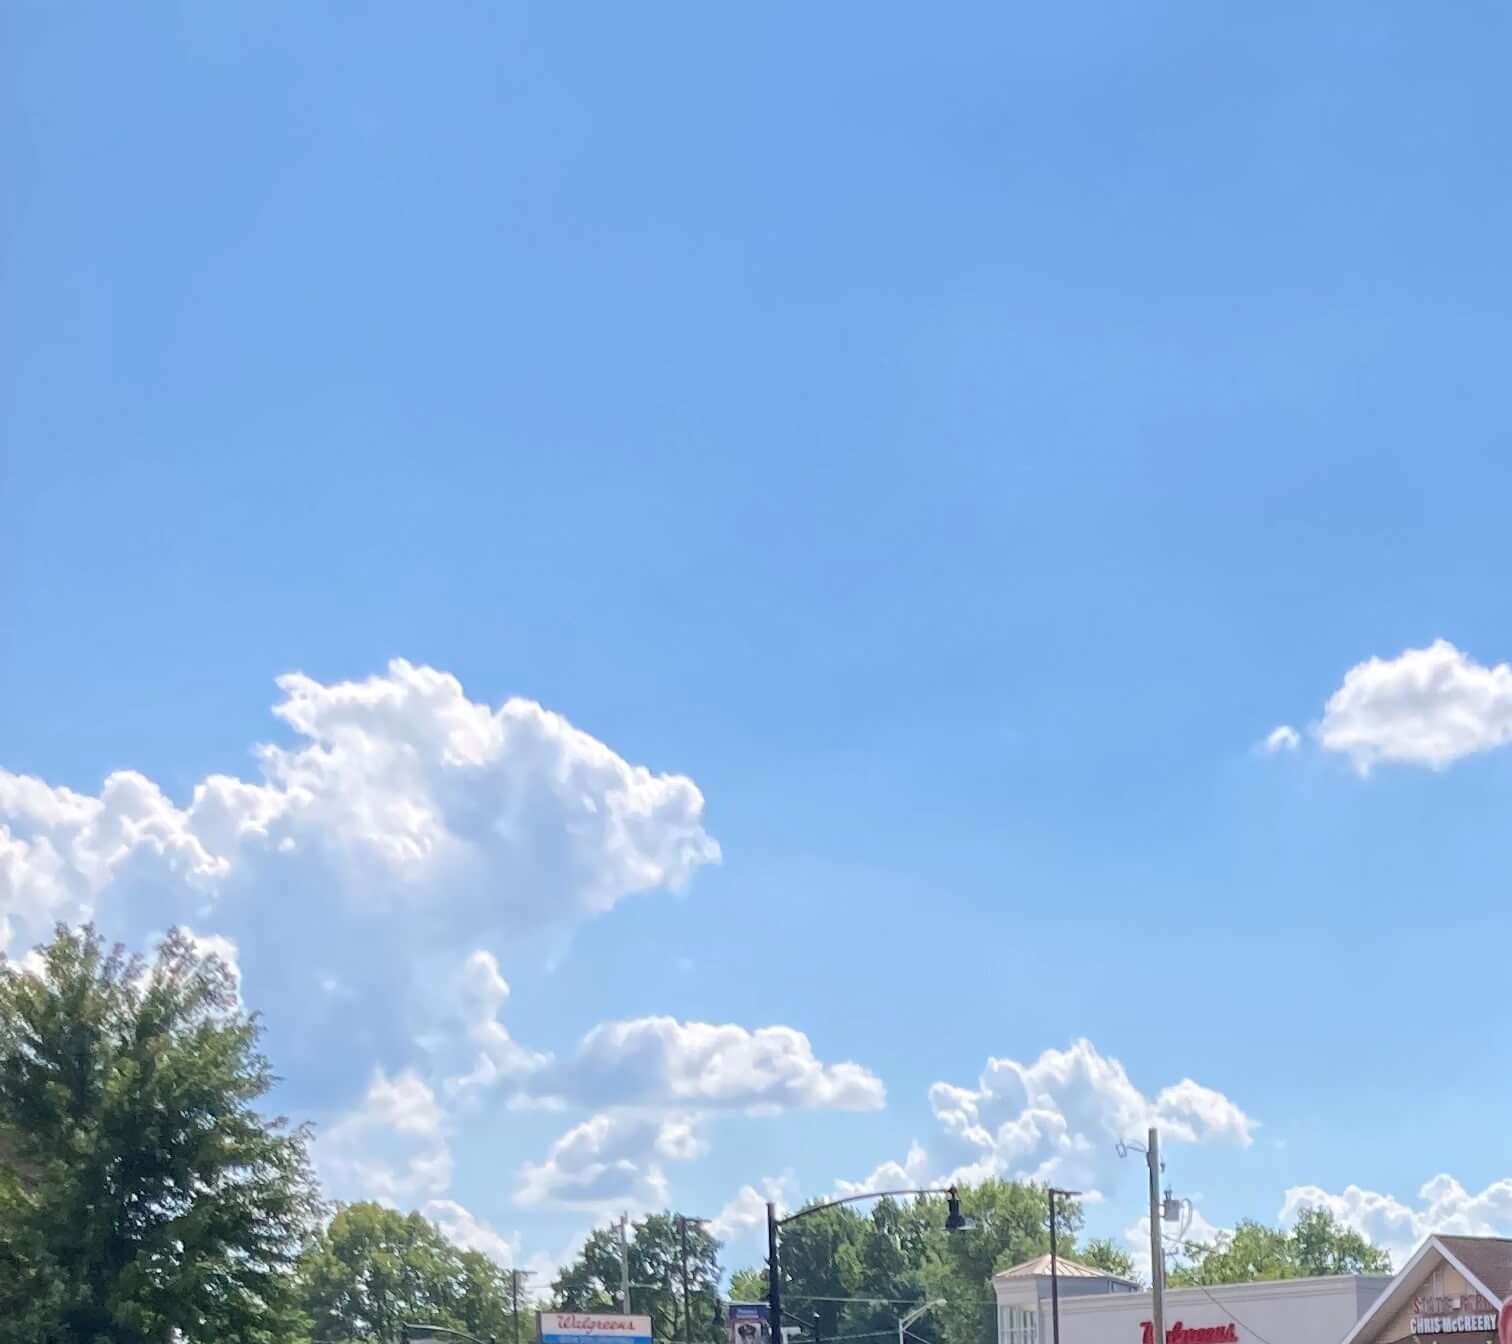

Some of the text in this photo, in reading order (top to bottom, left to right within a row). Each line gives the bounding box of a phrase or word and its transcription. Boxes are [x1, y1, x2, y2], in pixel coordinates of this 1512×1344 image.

[556, 1314, 636, 1334] Walgreens
[1410, 1314, 1497, 1334] CHRIS McCREERY
